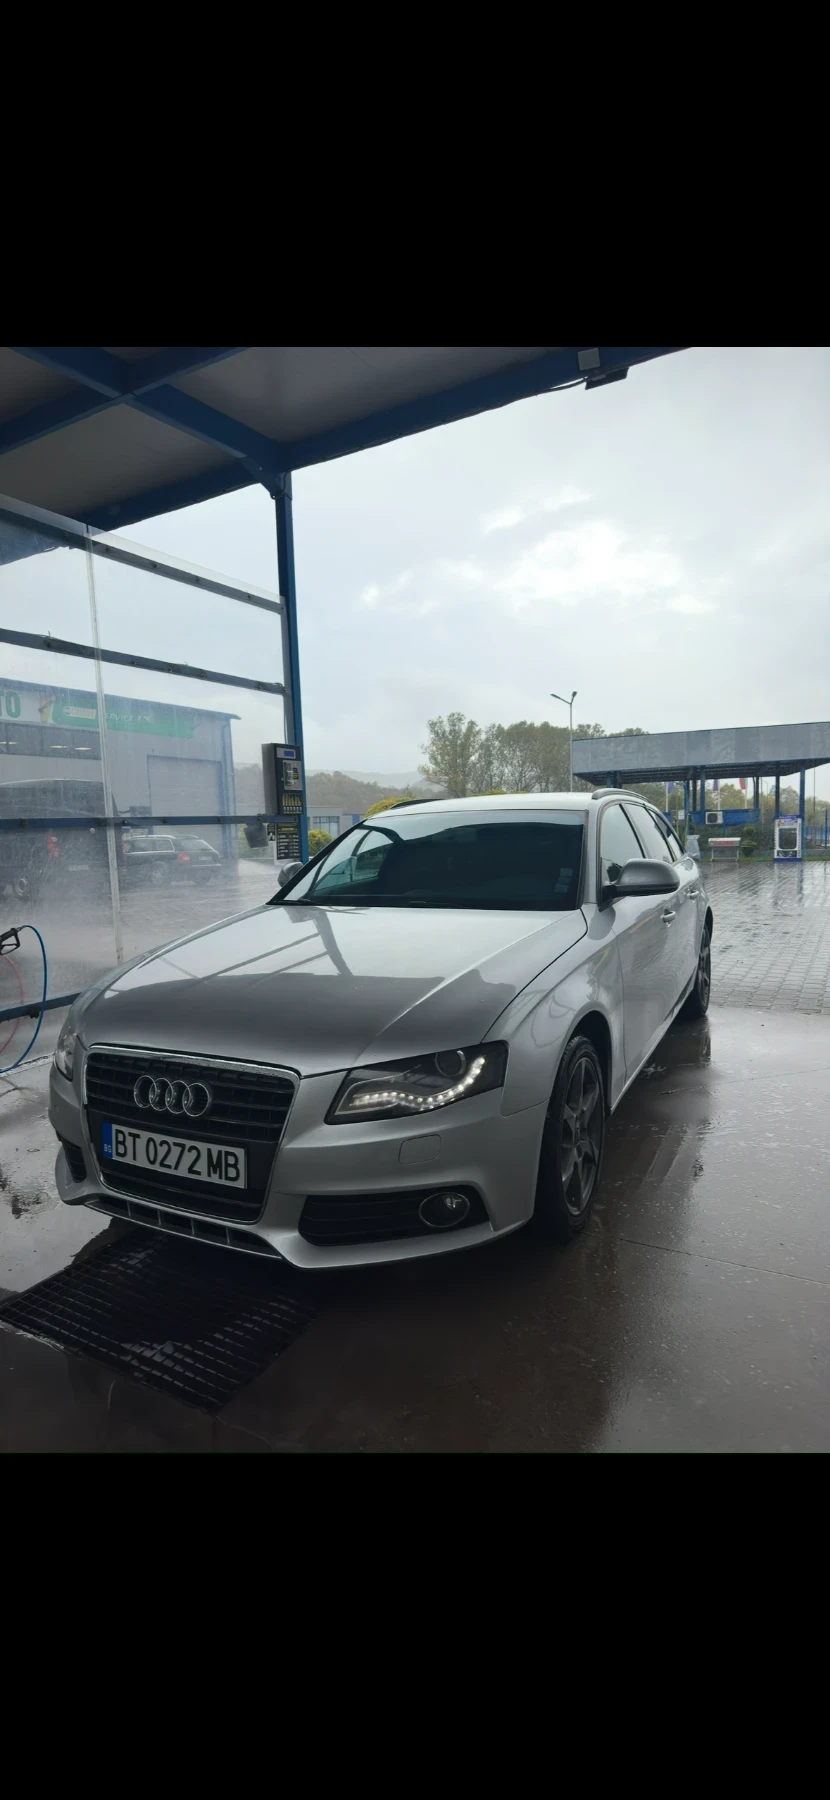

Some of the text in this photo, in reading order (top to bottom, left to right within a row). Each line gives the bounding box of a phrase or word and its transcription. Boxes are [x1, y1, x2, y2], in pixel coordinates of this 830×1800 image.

[103, 1143, 112, 1153] BG
[114, 1128, 241, 1182] BT 0272 MB
